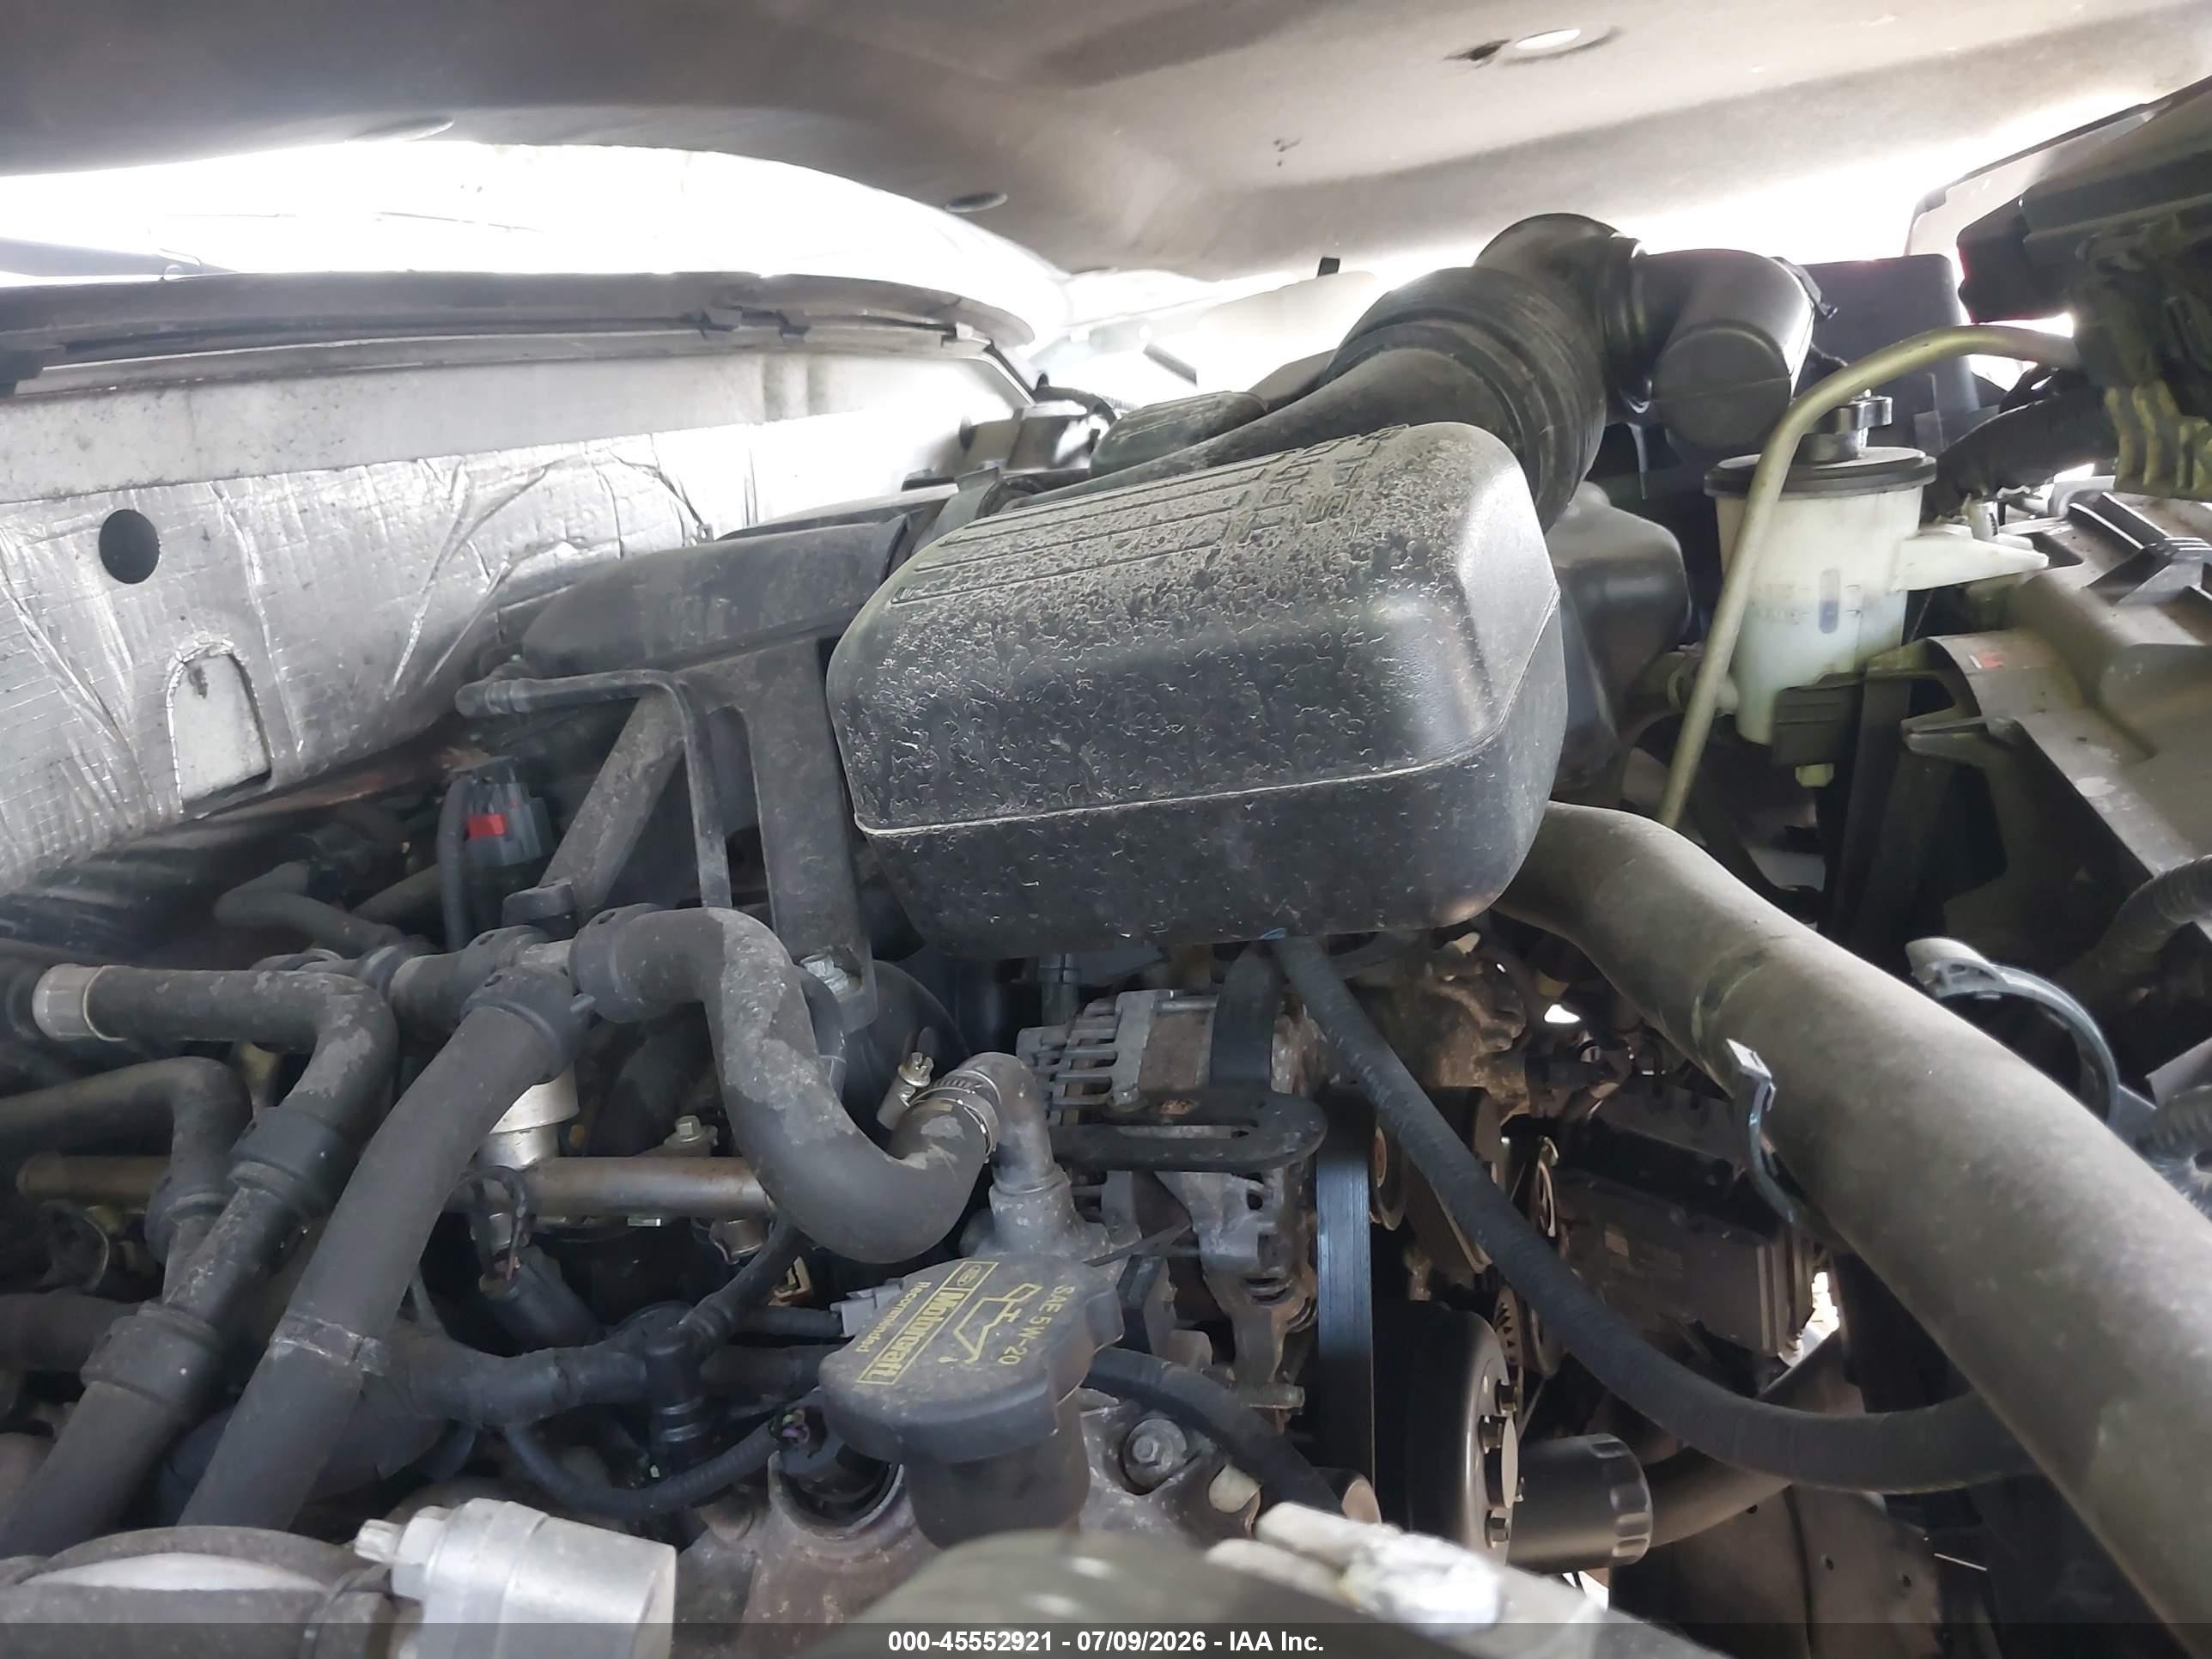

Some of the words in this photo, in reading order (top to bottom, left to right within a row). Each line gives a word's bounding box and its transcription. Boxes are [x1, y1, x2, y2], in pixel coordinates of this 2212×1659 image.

[855, 1281, 931, 1352] Recommended
[1039, 1285, 1076, 1312] SAE
[865, 1291, 966, 1381] Motorcraft
[998, 1316, 1052, 1364] 5W-20
